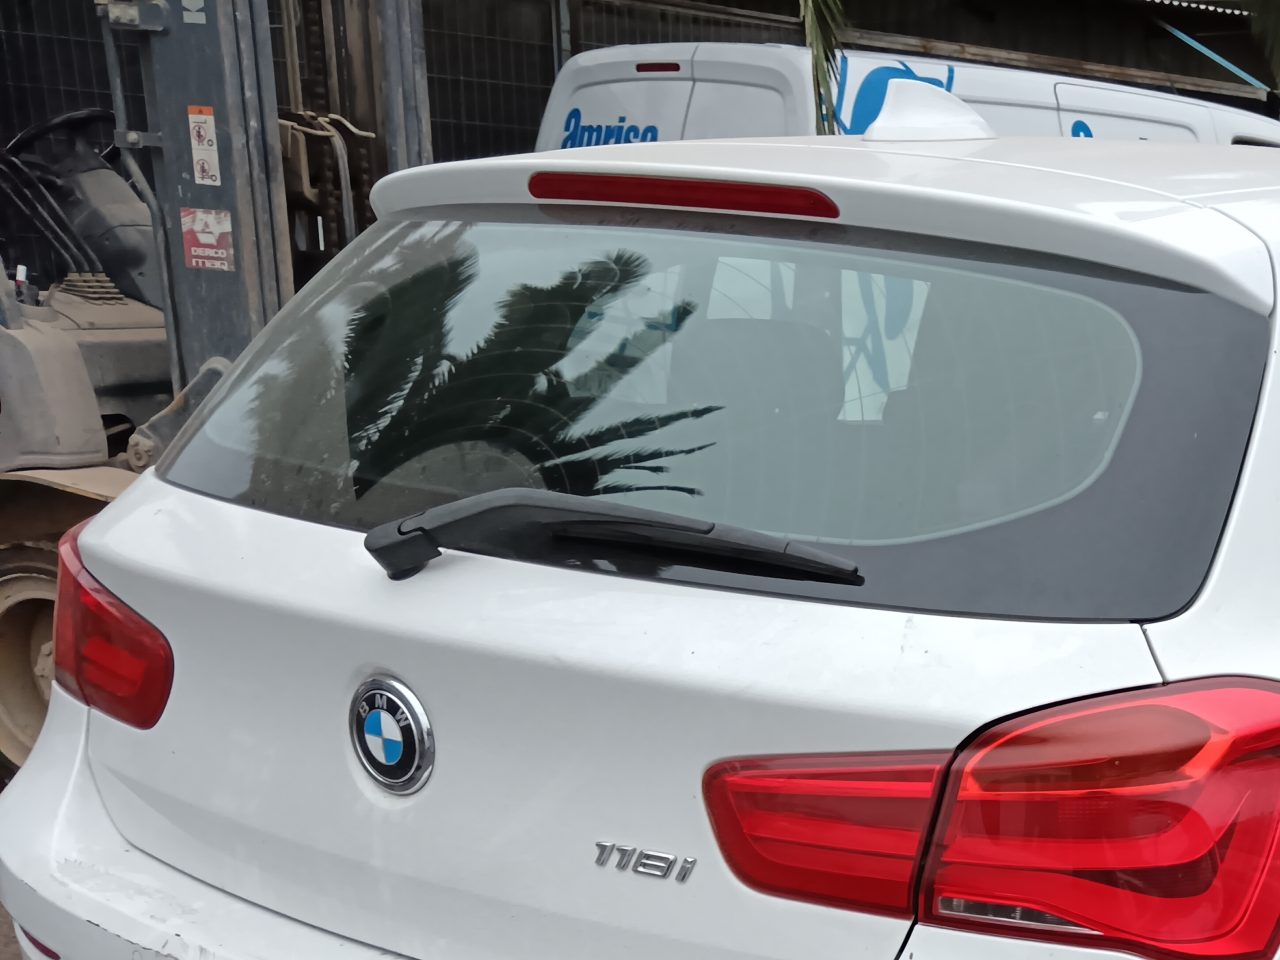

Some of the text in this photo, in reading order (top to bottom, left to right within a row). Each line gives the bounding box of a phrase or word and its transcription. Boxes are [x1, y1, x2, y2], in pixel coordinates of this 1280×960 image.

[191, 247, 227, 258] DERCO
[359, 693, 411, 728] BMW
[594, 841, 698, 885] 118i
